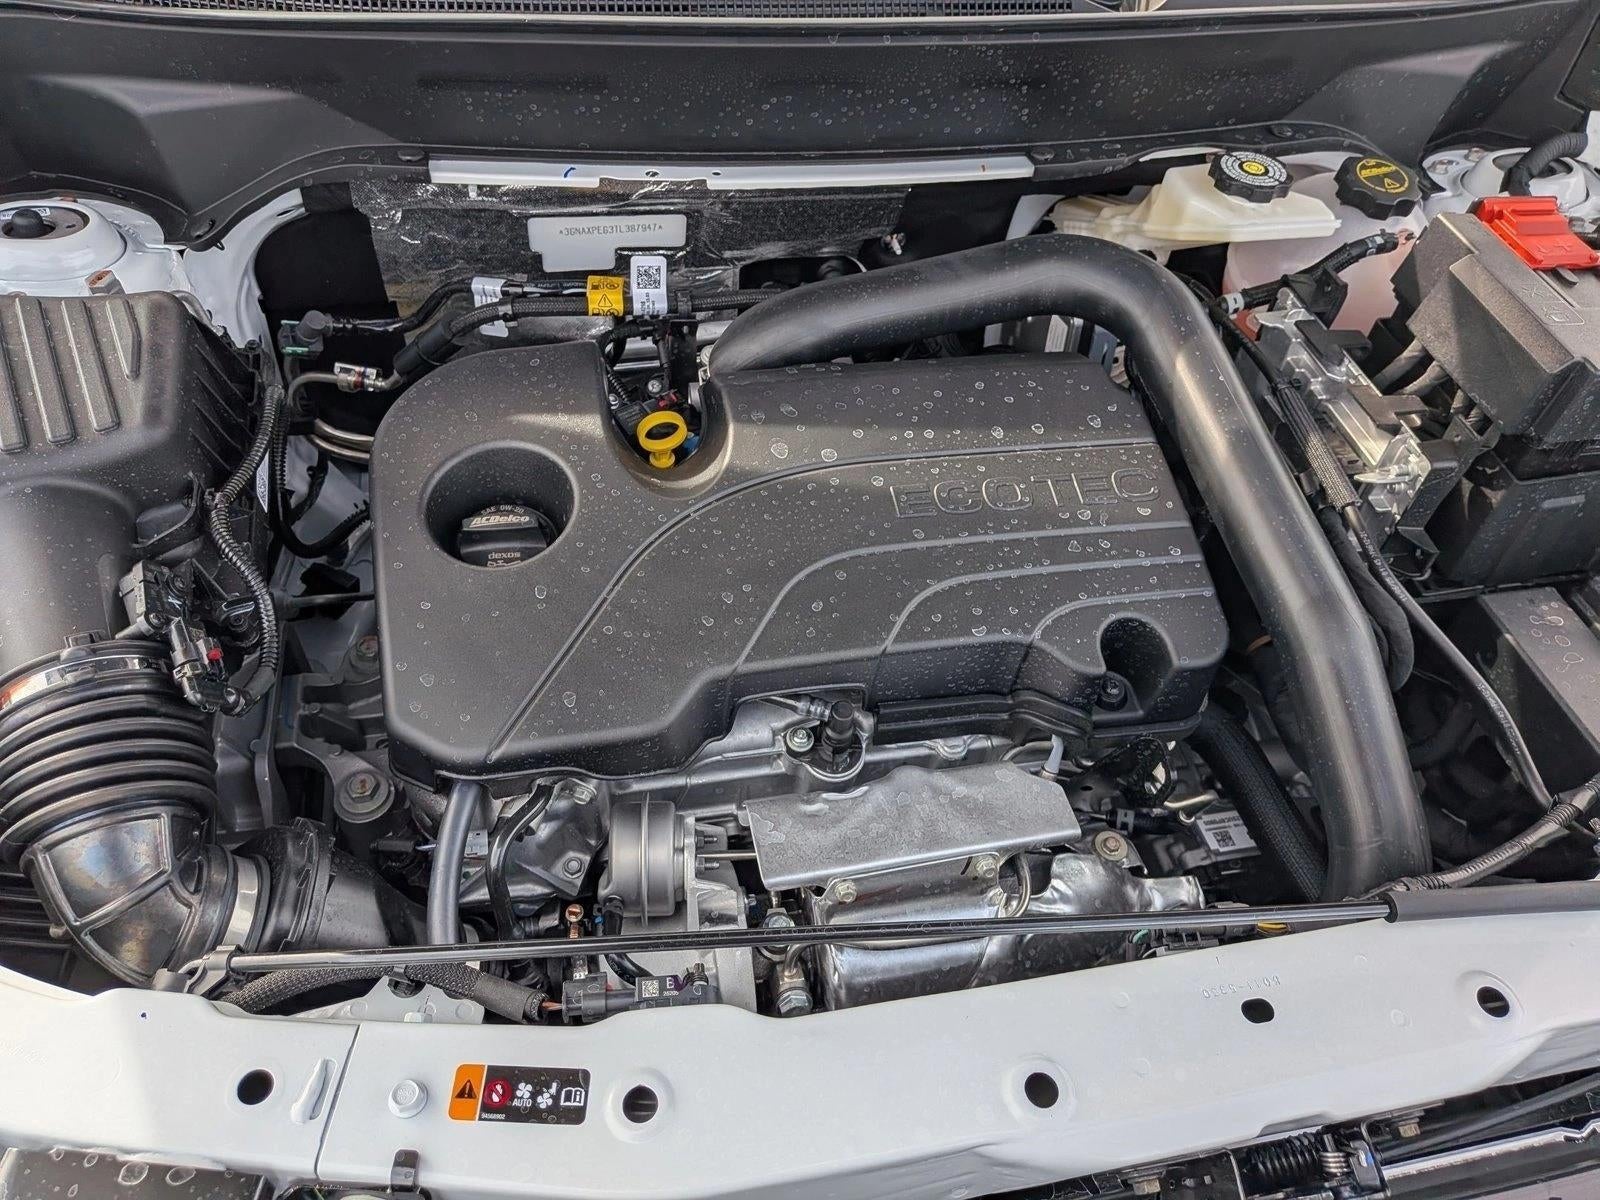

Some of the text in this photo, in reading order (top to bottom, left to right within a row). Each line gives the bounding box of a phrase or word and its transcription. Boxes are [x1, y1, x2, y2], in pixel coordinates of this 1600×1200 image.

[889, 468, 1160, 519] ECOTEC
[481, 504, 525, 516] SAE 0W-20
[469, 514, 530, 528] ACDelco
[488, 551, 521, 560] dexos
[512, 1098, 533, 1107] AUTO
